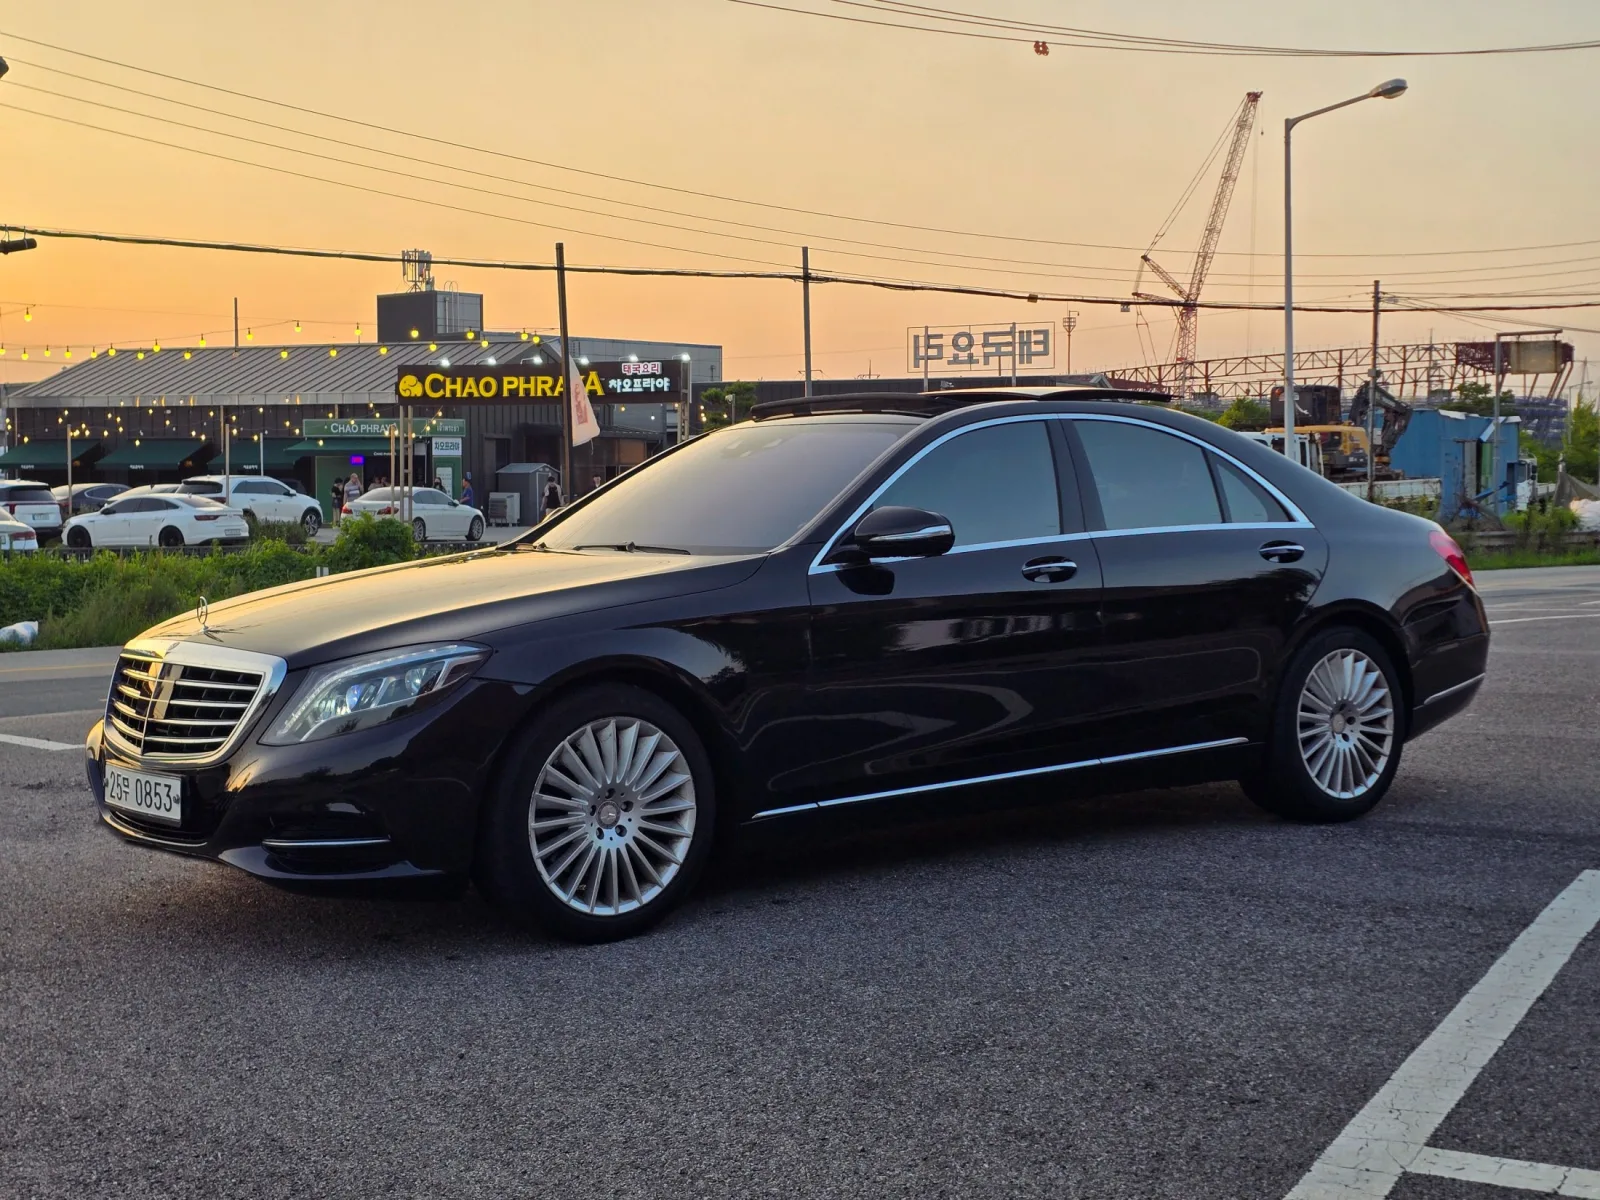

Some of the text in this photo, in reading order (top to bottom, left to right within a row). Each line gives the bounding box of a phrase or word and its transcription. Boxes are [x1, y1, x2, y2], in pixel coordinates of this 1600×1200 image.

[622, 362, 661, 375] 태국요리
[424, 371, 605, 398] CHAO PHRAA
[608, 377, 670, 393] 차오프라야
[330, 423, 358, 433] CHAO
[434, 441, 460, 451] 차오프라야
[110, 771, 173, 812] 25무 0853
